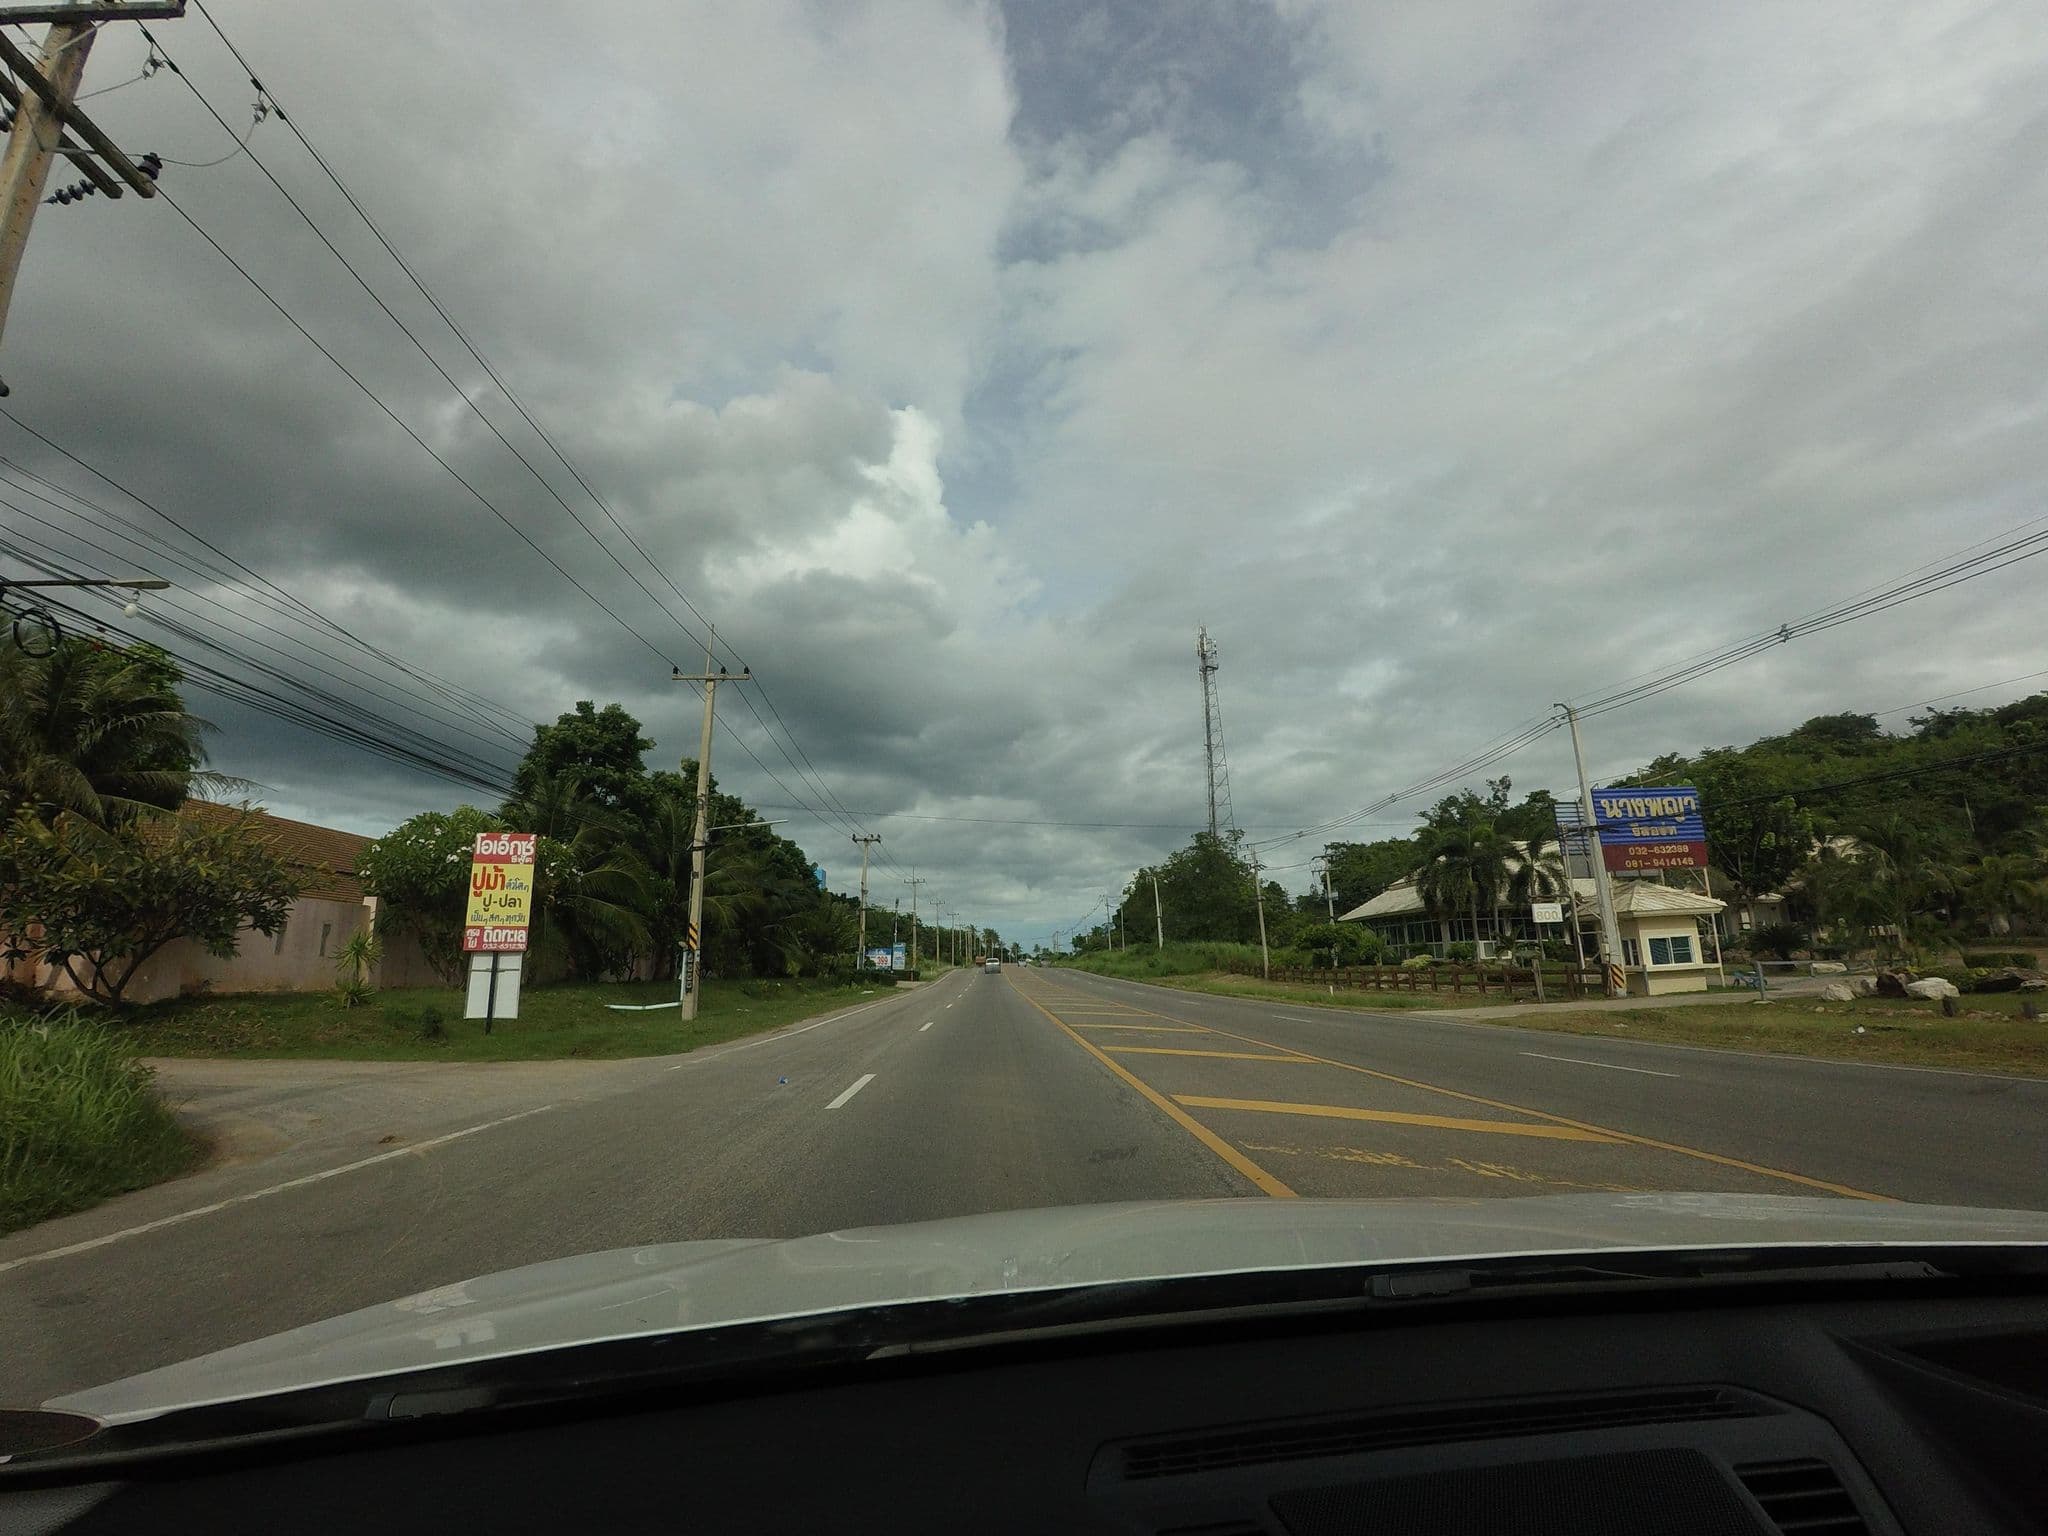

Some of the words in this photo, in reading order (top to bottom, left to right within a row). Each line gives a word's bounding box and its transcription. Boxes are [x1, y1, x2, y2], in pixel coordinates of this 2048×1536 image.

[1601, 797, 1696, 824] นางพญา
[472, 866, 505, 897] ปูม้า
[483, 894, 522, 912] ปู-ปลา
